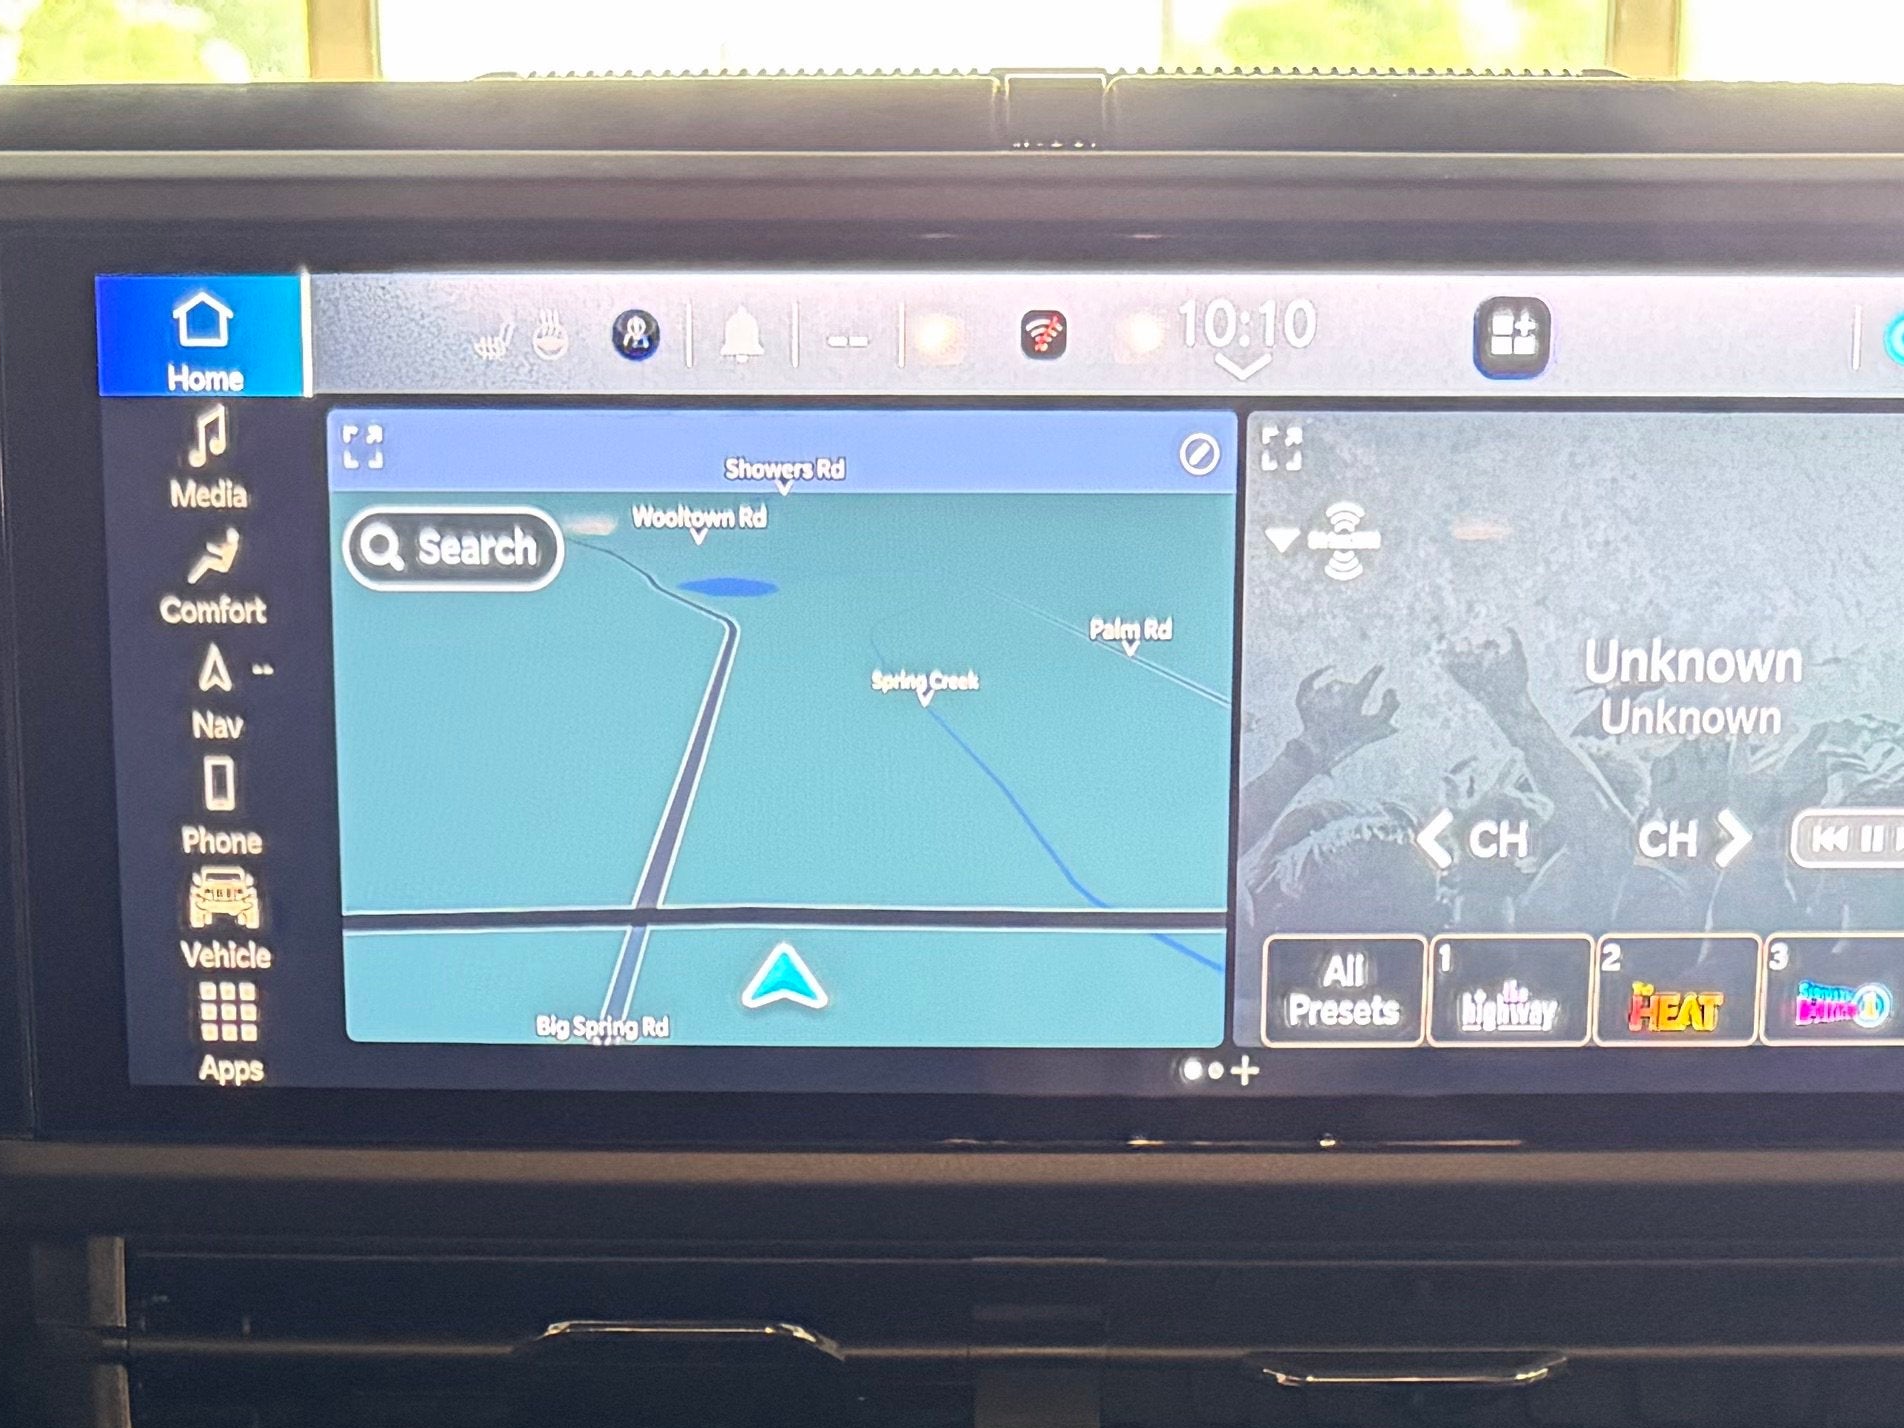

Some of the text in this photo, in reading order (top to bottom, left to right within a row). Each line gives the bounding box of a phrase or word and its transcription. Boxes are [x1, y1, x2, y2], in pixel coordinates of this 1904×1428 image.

[1178, 299, 1317, 349] 10:10
[167, 365, 245, 392] Home
[725, 457, 845, 481] Showers Rd
[170, 480, 247, 509] Media
[632, 504, 767, 529] Wooltown Rd
[419, 526, 537, 566] Search
[160, 595, 267, 624] Comfort
[1090, 617, 1173, 641] Palm Rd
[1585, 638, 1802, 684] Unknown
[871, 670, 980, 695] Spring Creek
[193, 711, 243, 739] Nav
[1601, 699, 1781, 735] Unknown
[182, 826, 263, 854] Phone
[1469, 821, 1528, 858] CH
[1638, 821, 1696, 858] CH
[181, 941, 272, 969] Vehicle
[1438, 944, 1452, 972] 1
[1602, 944, 1621, 972] 2
[1769, 943, 1788, 970] 3
[1323, 955, 1364, 988] All
[1289, 993, 1400, 1029] Presets
[1461, 990, 1558, 1031] highway
[1629, 991, 1724, 1031] HEAT
[536, 1015, 668, 1043] Big Spring Rd
[199, 1056, 265, 1086] Apps
